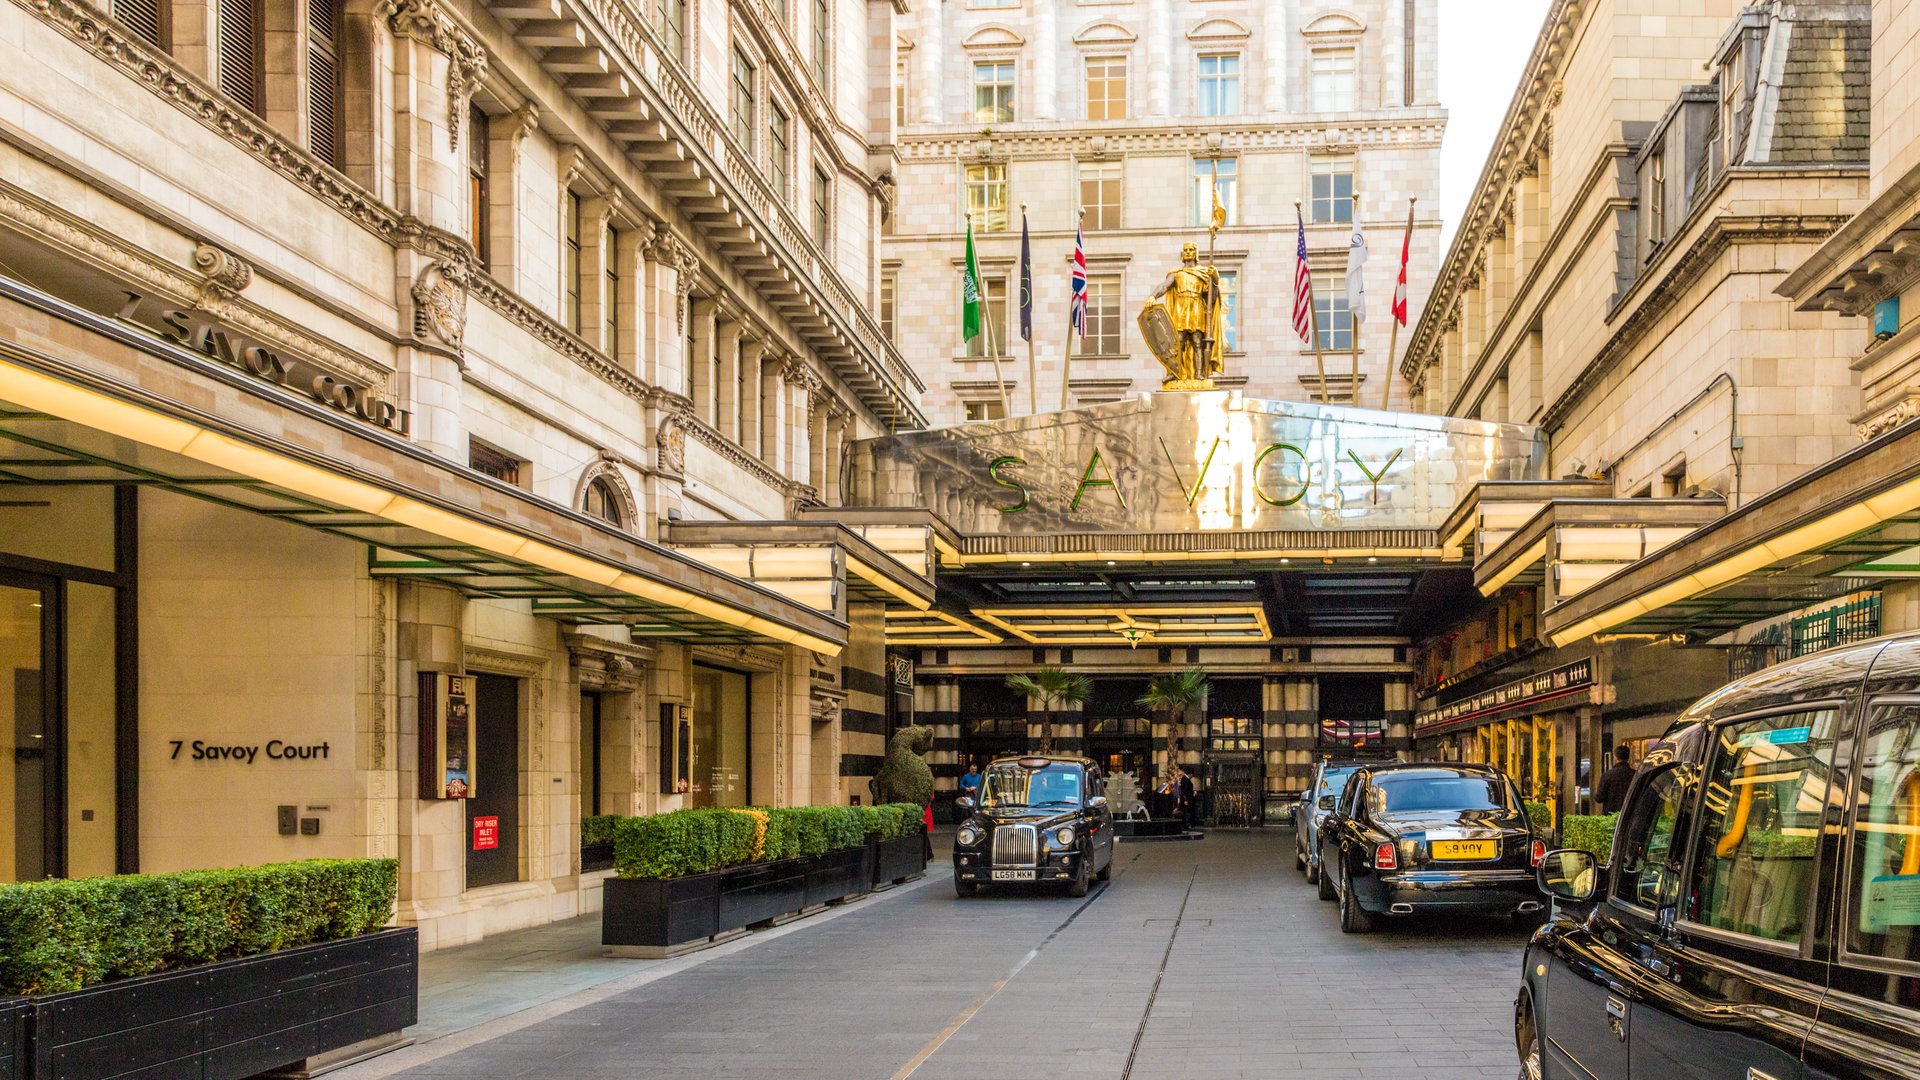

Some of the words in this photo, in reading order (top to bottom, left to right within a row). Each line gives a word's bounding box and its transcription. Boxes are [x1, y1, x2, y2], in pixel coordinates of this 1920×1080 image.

[162, 310, 297, 385] SAVOY
[312, 375, 414, 435] COURT
[988, 436, 1403, 513] SAVOY
[1211, 702, 1259, 713] SAVOY
[169, 740, 183, 760] 7
[192, 740, 259, 765] Savoy
[265, 740, 330, 760] Court
[1462, 844, 1482, 854] VOY
[994, 871, 1015, 879] LG58
